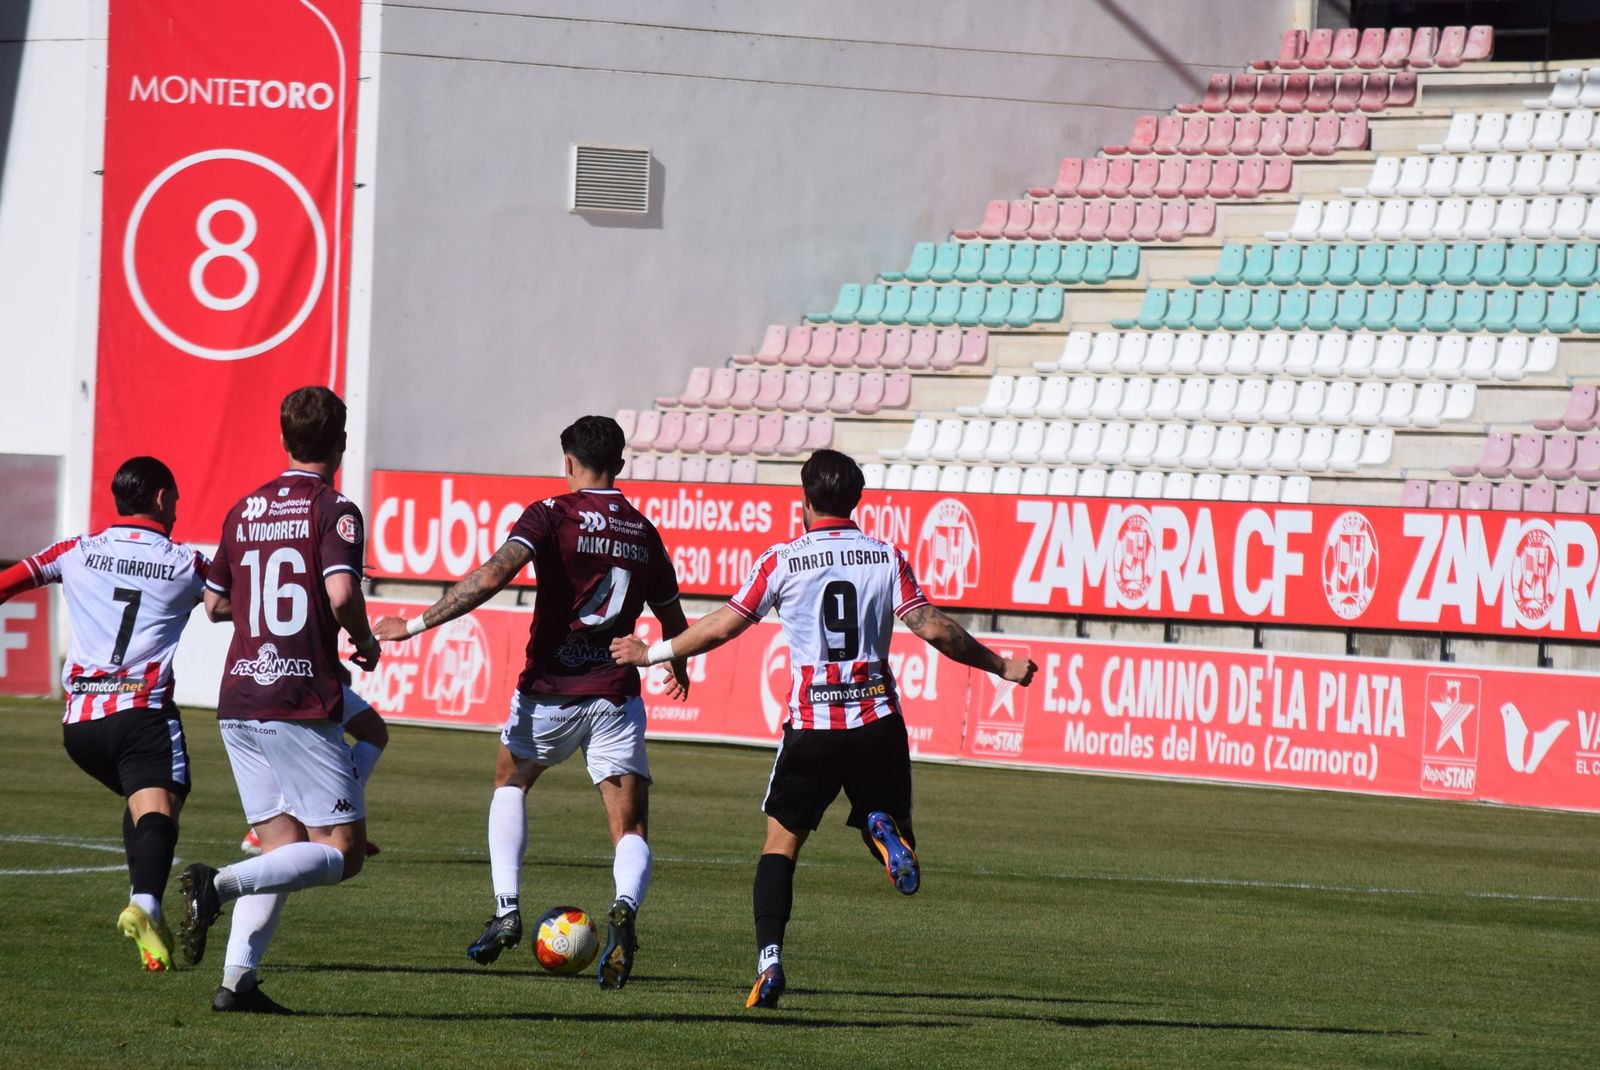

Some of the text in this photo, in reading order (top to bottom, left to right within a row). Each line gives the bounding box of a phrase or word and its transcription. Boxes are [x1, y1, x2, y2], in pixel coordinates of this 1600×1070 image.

[129, 75, 334, 110] MONTETORO
[189, 199, 260, 311] 8
[236, 520, 310, 542] A. VIDORRETA
[373, 478, 538, 580] cubie
[116, 556, 176, 581] MÁRQUEZ
[577, 536, 649, 565] MIKI BOSCH
[674, 546, 710, 586] 630
[788, 550, 834, 573] MARIO
[840, 550, 890, 567] LOSADA
[1012, 500, 1313, 617] ZAMORA CF
[240, 547, 308, 638] 16
[110, 587, 142, 666] 7
[823, 581, 859, 662] 9
[810, 683, 886, 702] leomotor.ne
[1044, 653, 1406, 738] E.S. CAMINO DE LA PLATA
[652, 706, 700, 720] COMPANY
[1064, 721, 1378, 781] Morales del Vino (Zamora)
[1576, 760, 1590, 774] EL
